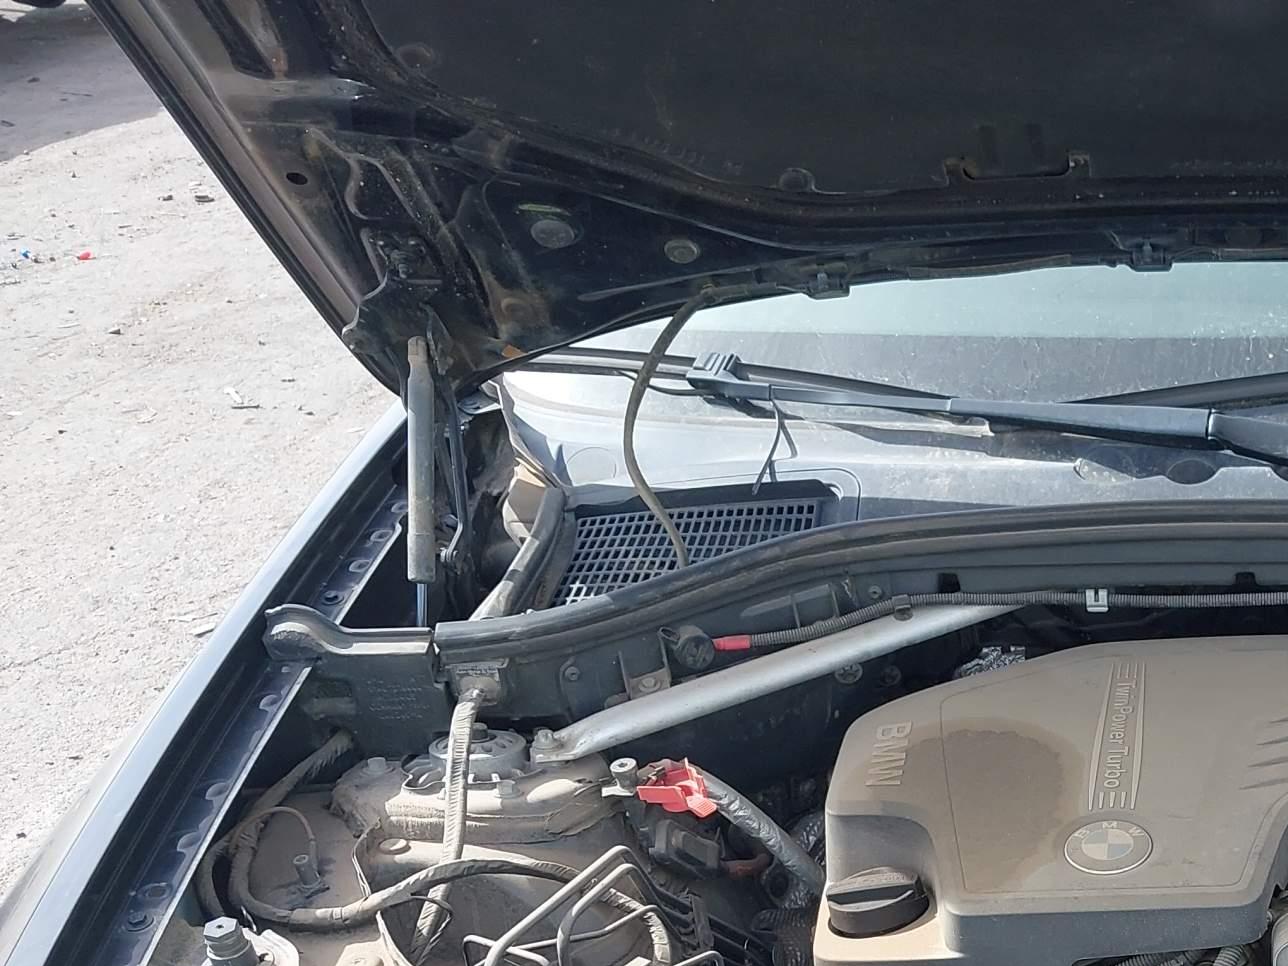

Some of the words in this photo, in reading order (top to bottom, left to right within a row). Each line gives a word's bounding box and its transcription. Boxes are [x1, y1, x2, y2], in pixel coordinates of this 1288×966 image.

[1109, 680, 1137, 745] TwinPower
[864, 719, 913, 788] BMW
[1103, 745, 1129, 789] Turbo
[1072, 820, 1145, 839] BMW
